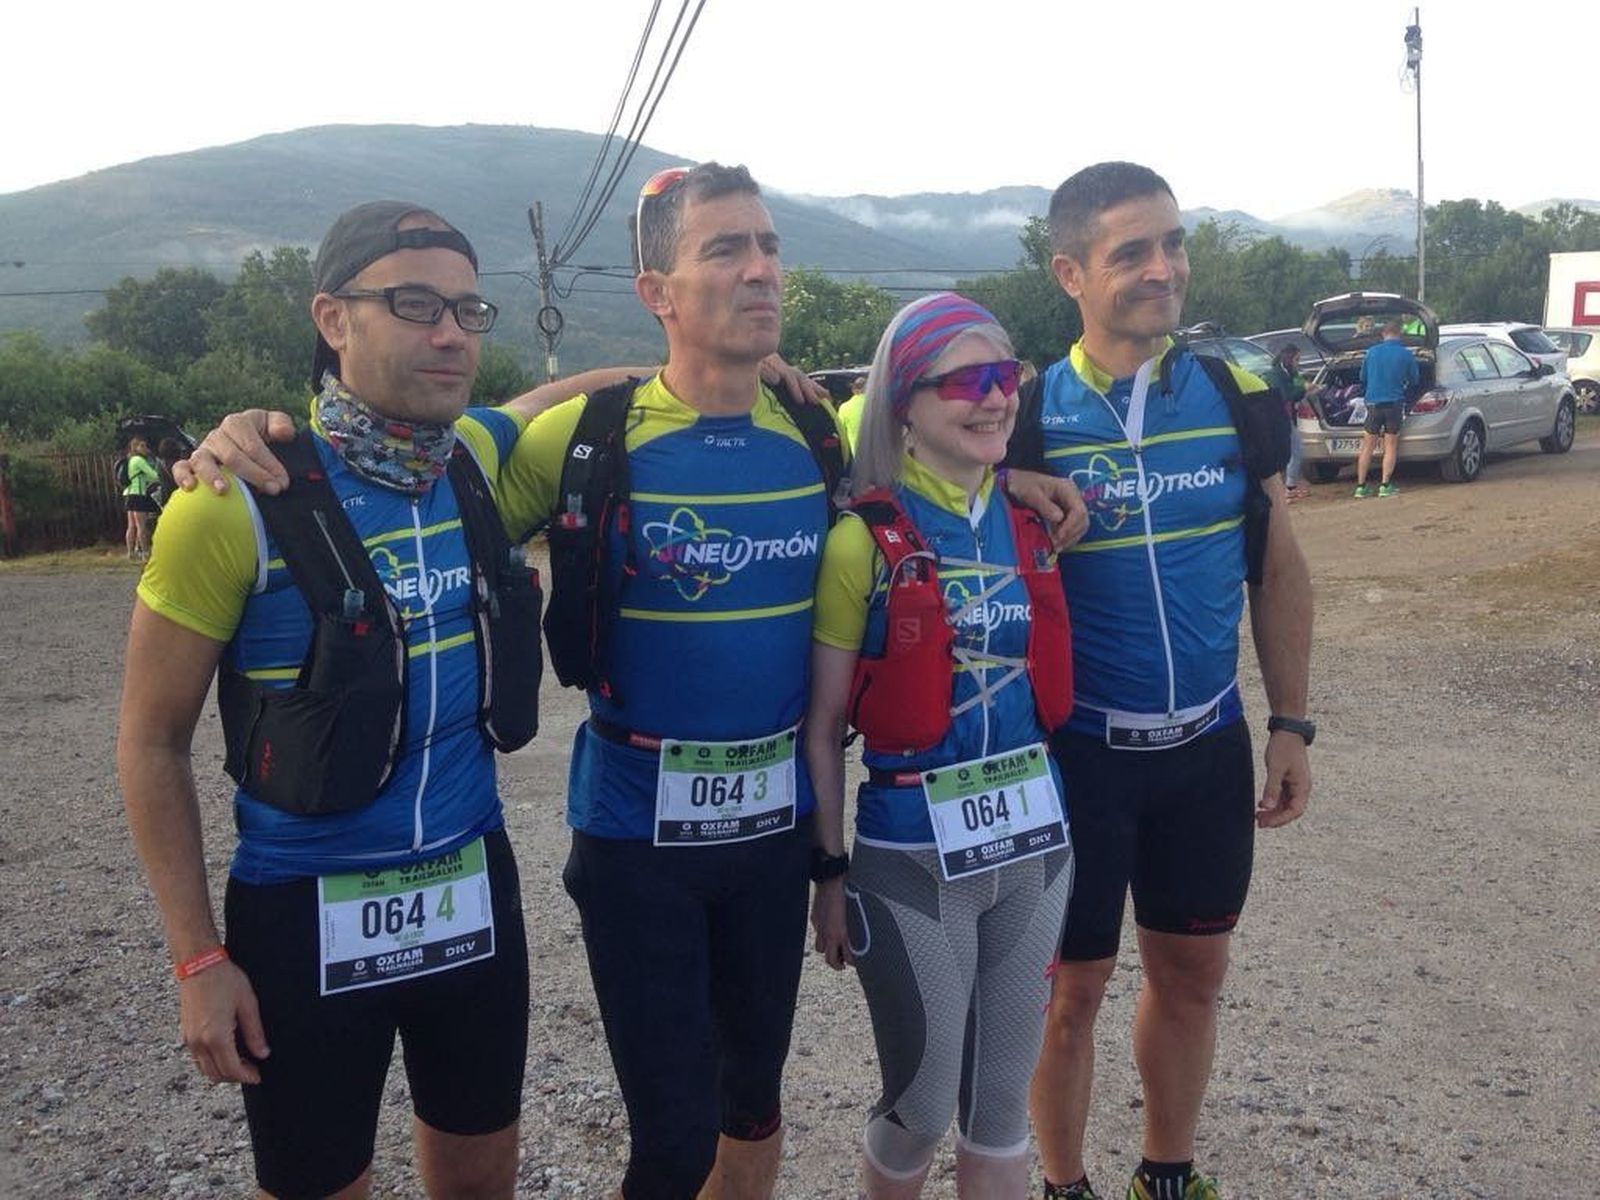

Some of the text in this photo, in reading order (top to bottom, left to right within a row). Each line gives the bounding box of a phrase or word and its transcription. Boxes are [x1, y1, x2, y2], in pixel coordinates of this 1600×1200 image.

[342, 494, 367, 509] CTIC
[683, 529, 819, 573] NEUTRÓN
[383, 566, 471, 605] NEUTR
[725, 740, 778, 759] OXFAM
[981, 754, 1028, 776] OXFAM
[691, 774, 745, 807] 064
[753, 771, 769, 801] 3
[961, 784, 1029, 832] 064 1
[700, 819, 740, 831] OXFAM
[981, 838, 1014, 855] OXFAM
[362, 892, 426, 940] 064
[436, 885, 456, 923] 4
[376, 940, 477, 967] OXFAM DKV
